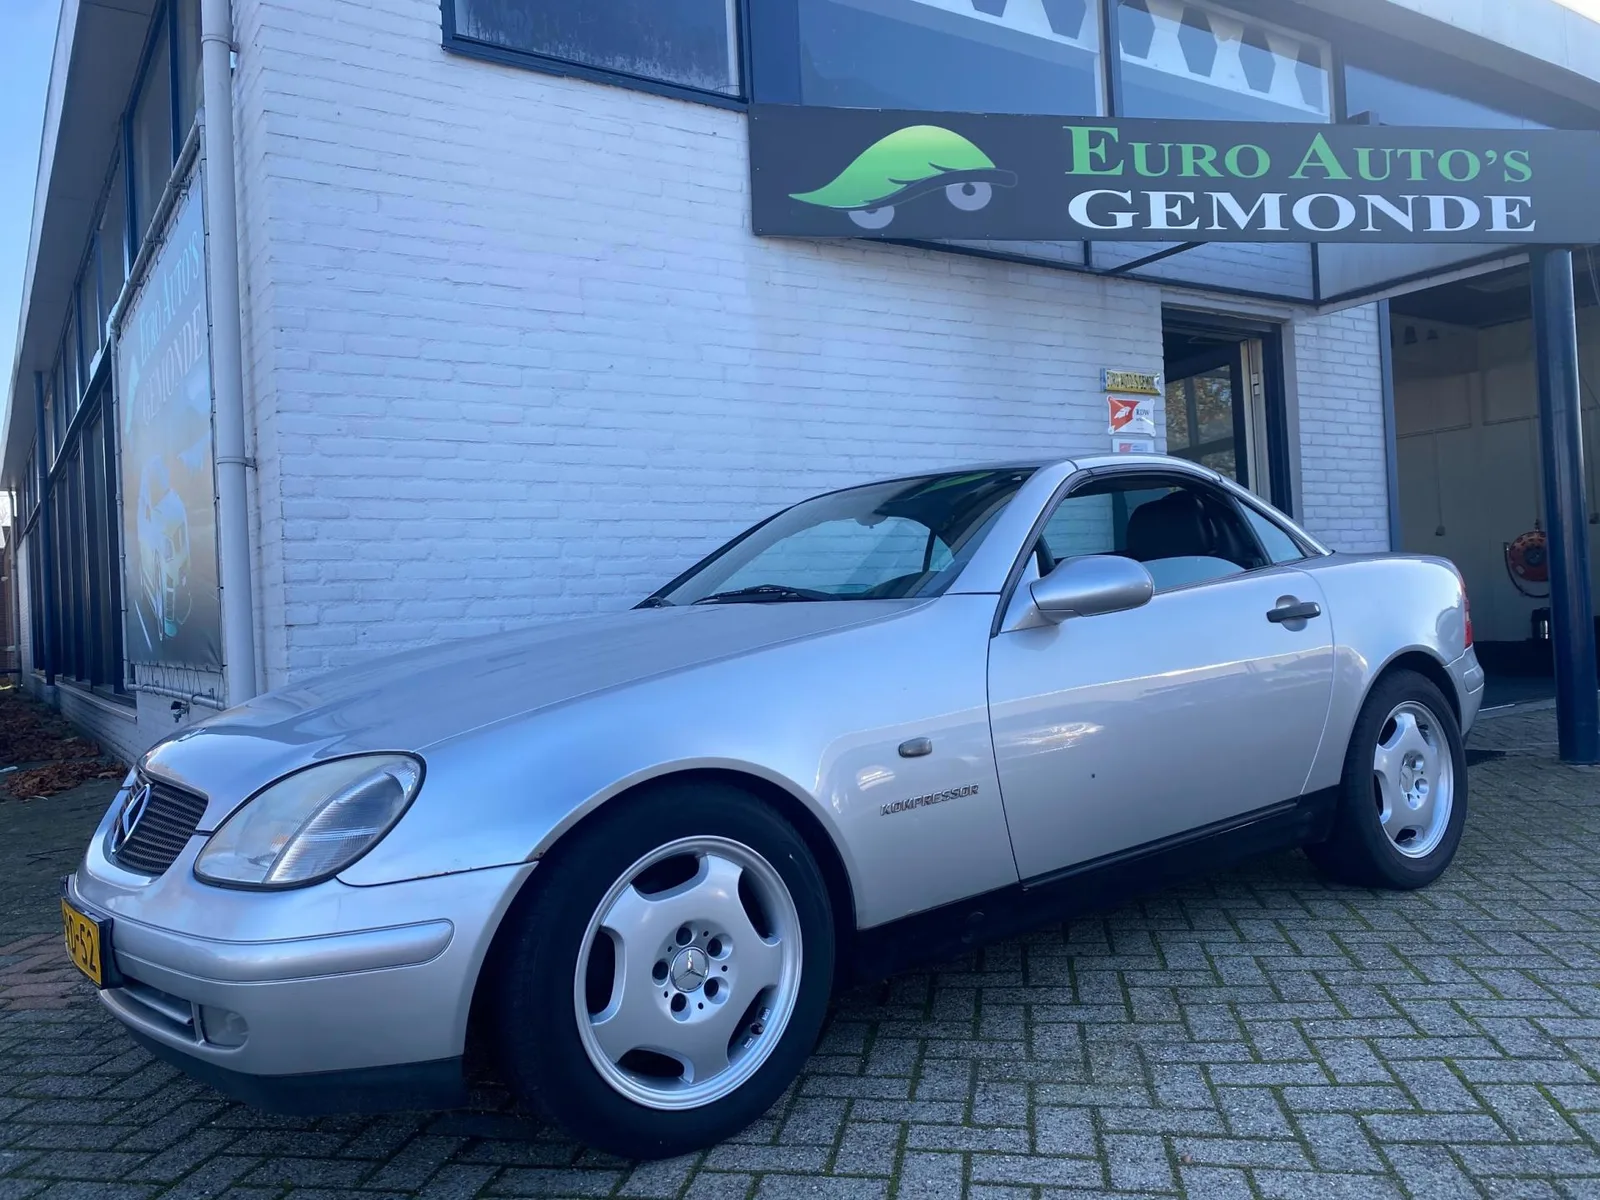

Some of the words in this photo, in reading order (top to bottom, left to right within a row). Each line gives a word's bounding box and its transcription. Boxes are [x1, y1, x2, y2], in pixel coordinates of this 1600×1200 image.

[1062, 125, 1271, 179] EURO
[1067, 189, 1537, 233] GEMONDE
[141, 302, 203, 426] GEMONDE
[880, 783, 979, 817] KOMPRESSOR
